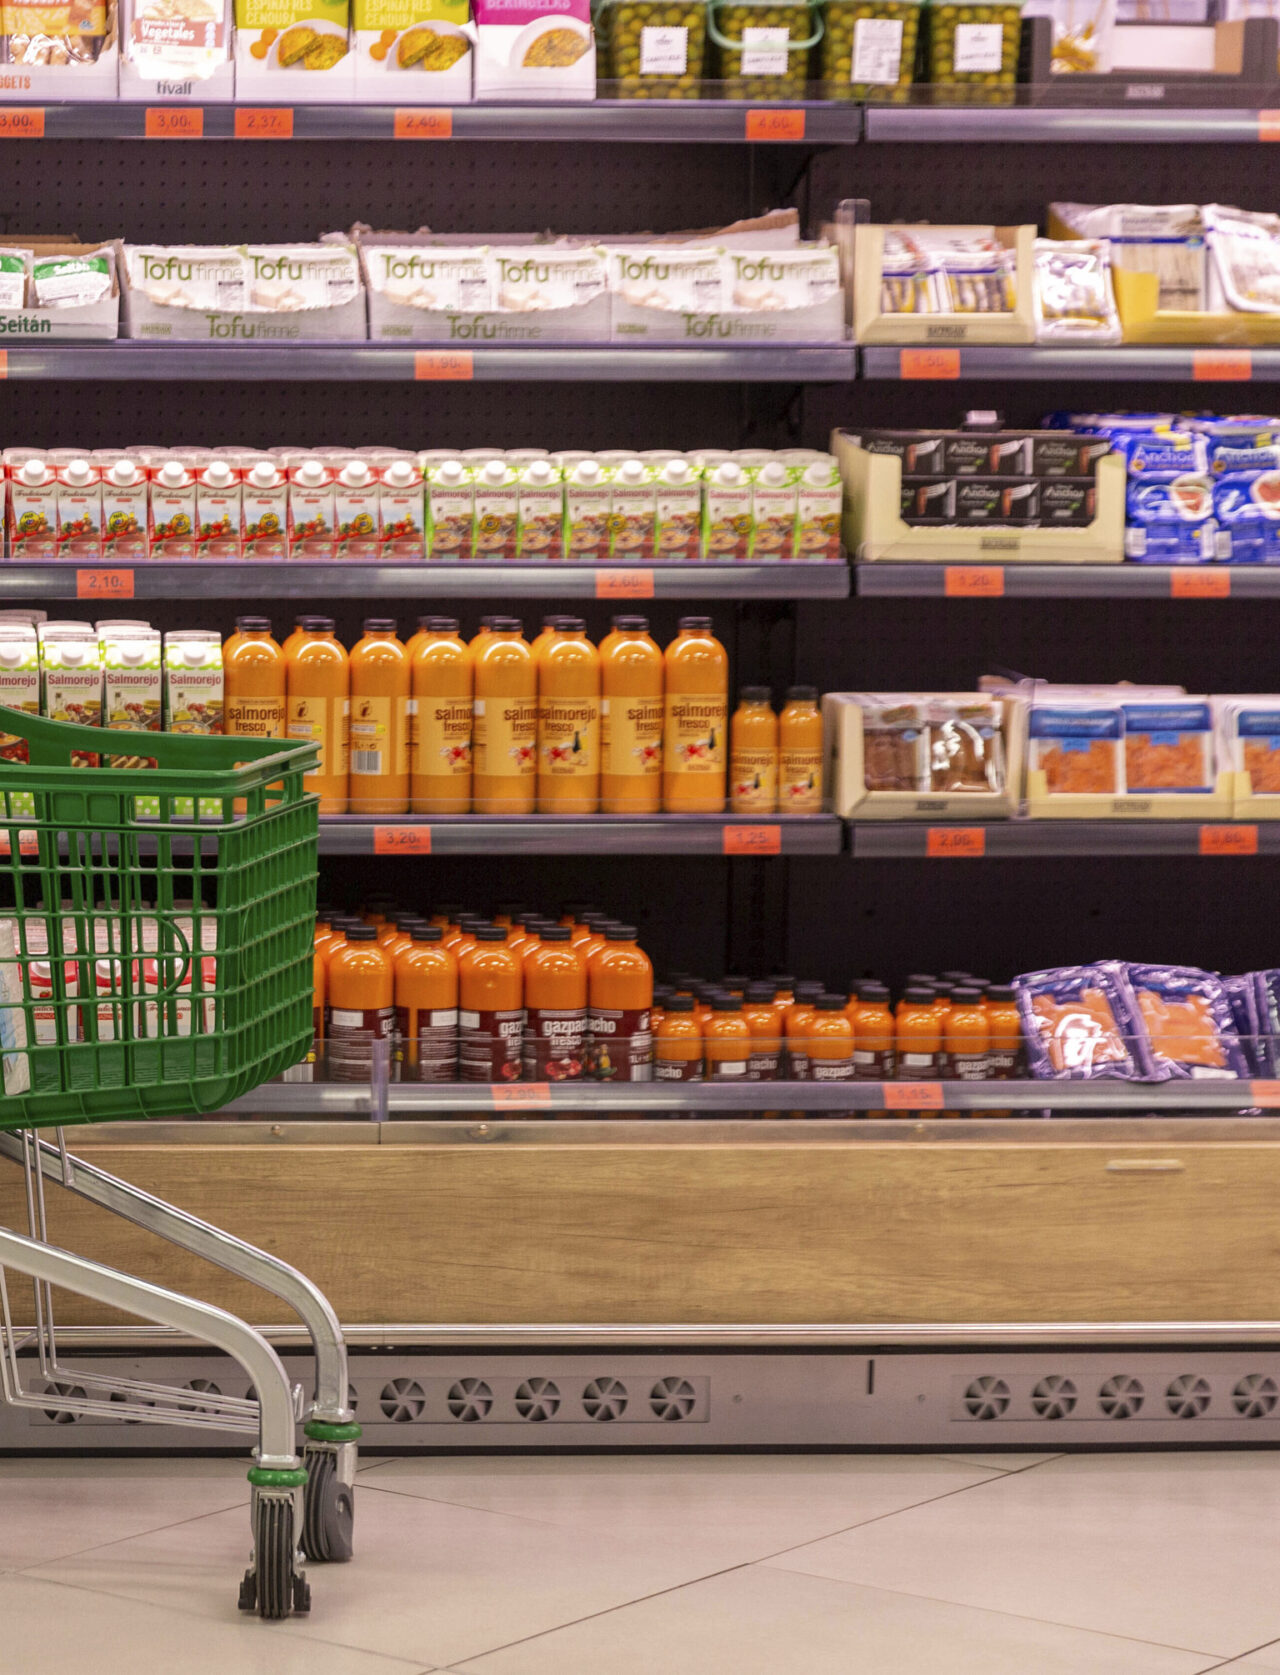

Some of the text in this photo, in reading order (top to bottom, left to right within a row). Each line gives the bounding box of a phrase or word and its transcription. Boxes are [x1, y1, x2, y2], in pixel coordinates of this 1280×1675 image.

[139, 255, 192, 280] Tofu
[249, 255, 303, 280] Tofu
[381, 255, 434, 279] Tofu
[497, 258, 549, 283] Tofu
[616, 255, 669, 280] Tofu
[732, 256, 784, 281] Tofu
[206, 315, 255, 338] Tofu
[446, 315, 496, 338] Tofu
[683, 314, 731, 337] Tofu
[48, 674, 99, 687] Salmorejo
[107, 673, 159, 686] Salmorejo
[170, 673, 222, 687] Salmorejo
[235, 720, 267, 732] fresco
